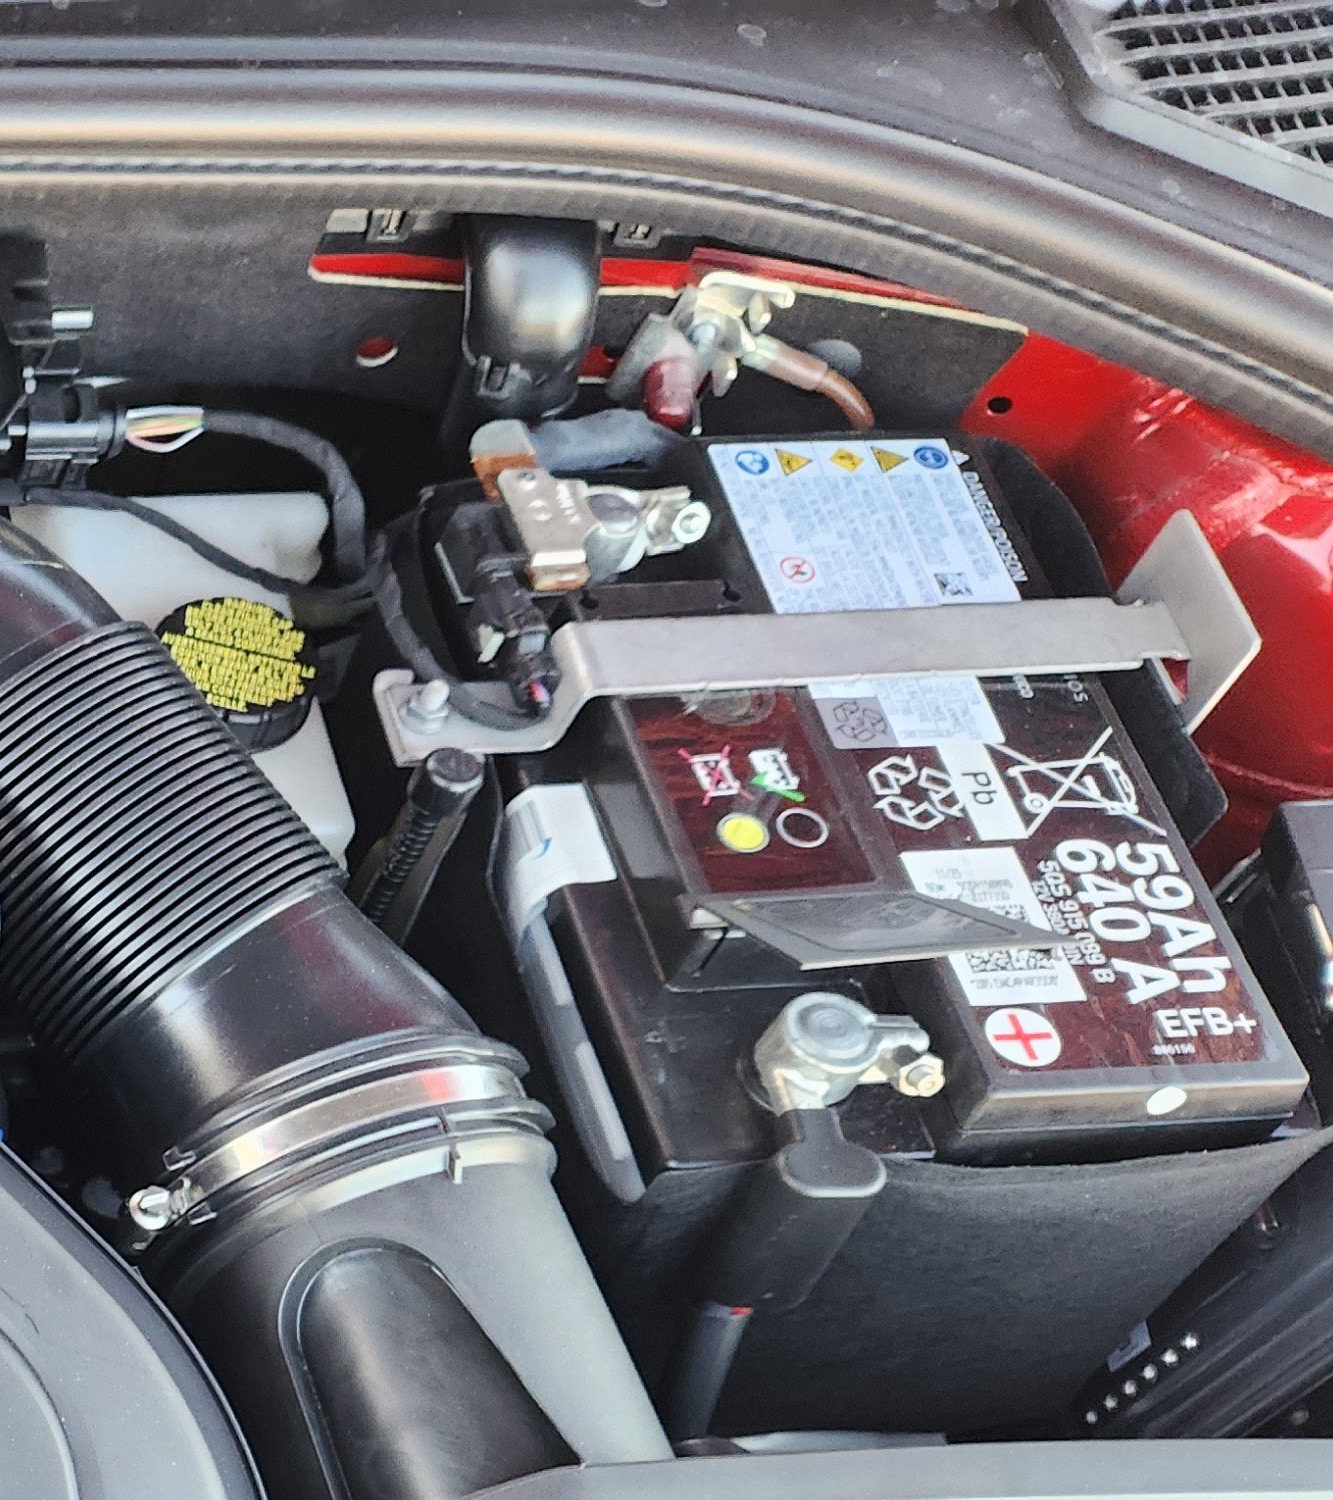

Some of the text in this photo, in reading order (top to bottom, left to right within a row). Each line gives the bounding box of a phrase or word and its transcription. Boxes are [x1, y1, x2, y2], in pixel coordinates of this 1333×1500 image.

[961, 771, 994, 806] Pb
[1055, 839, 1181, 1004] 640 A
[1059, 900, 1089, 934] 915
[1090, 968, 1116, 984] B
[1117, 841, 1232, 993] 59Ah
[1153, 1007, 1257, 1038] EFB+
